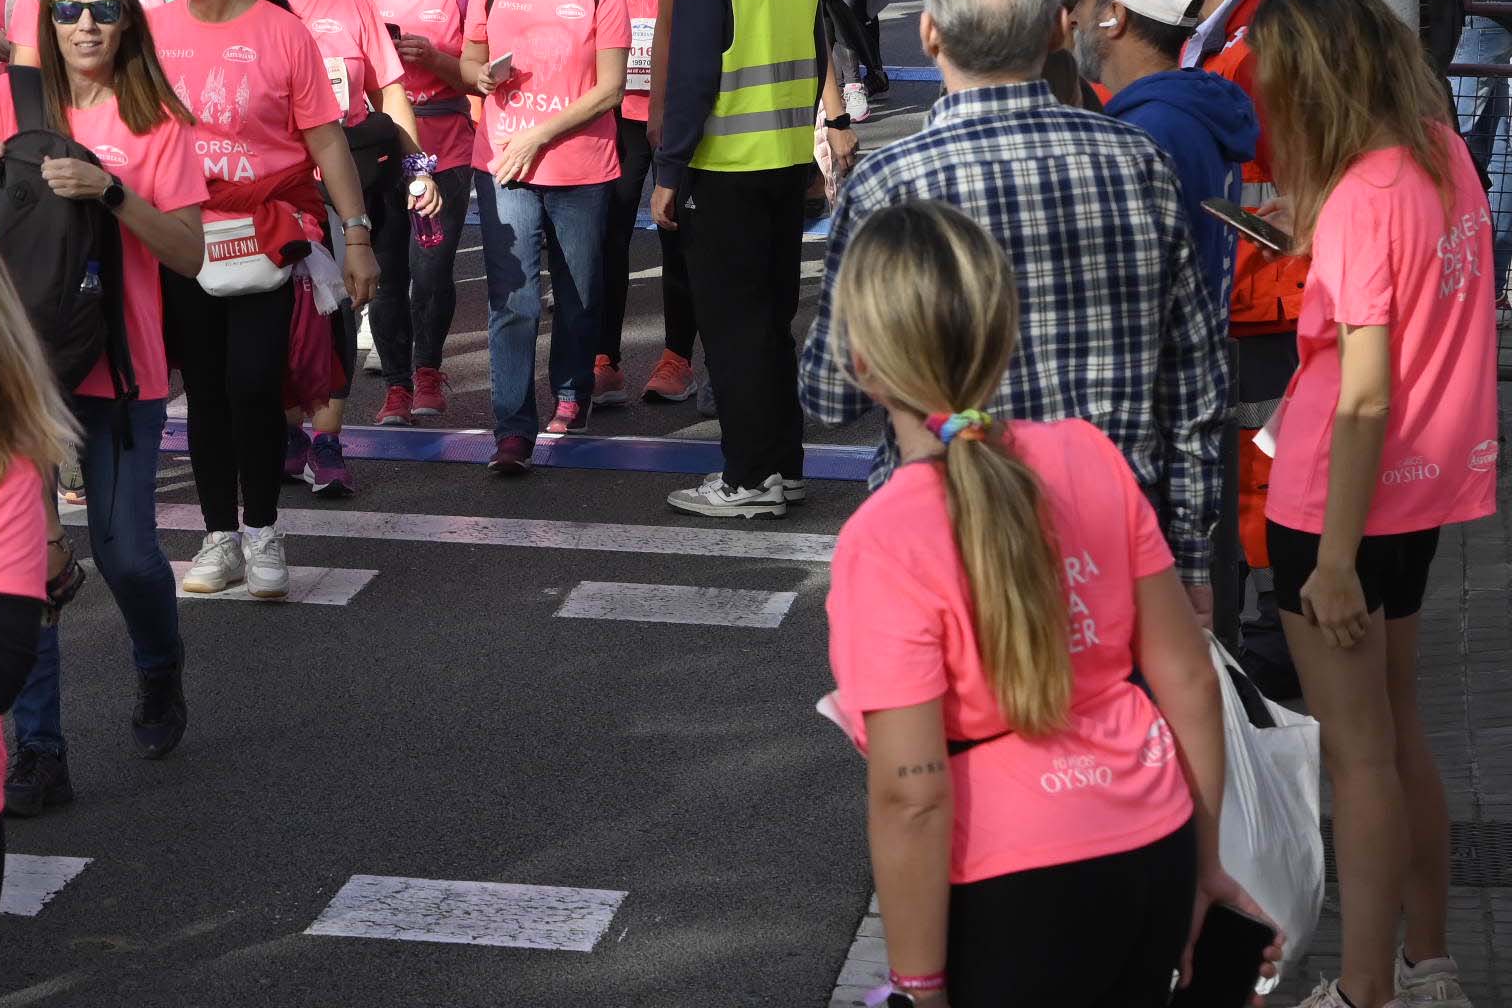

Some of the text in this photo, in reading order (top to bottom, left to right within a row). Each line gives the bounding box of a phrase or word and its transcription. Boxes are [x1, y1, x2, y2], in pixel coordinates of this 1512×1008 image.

[159, 49, 195, 59] OYSHO
[630, 47, 652, 56] 016
[1381, 463, 1440, 486] OYSHO
